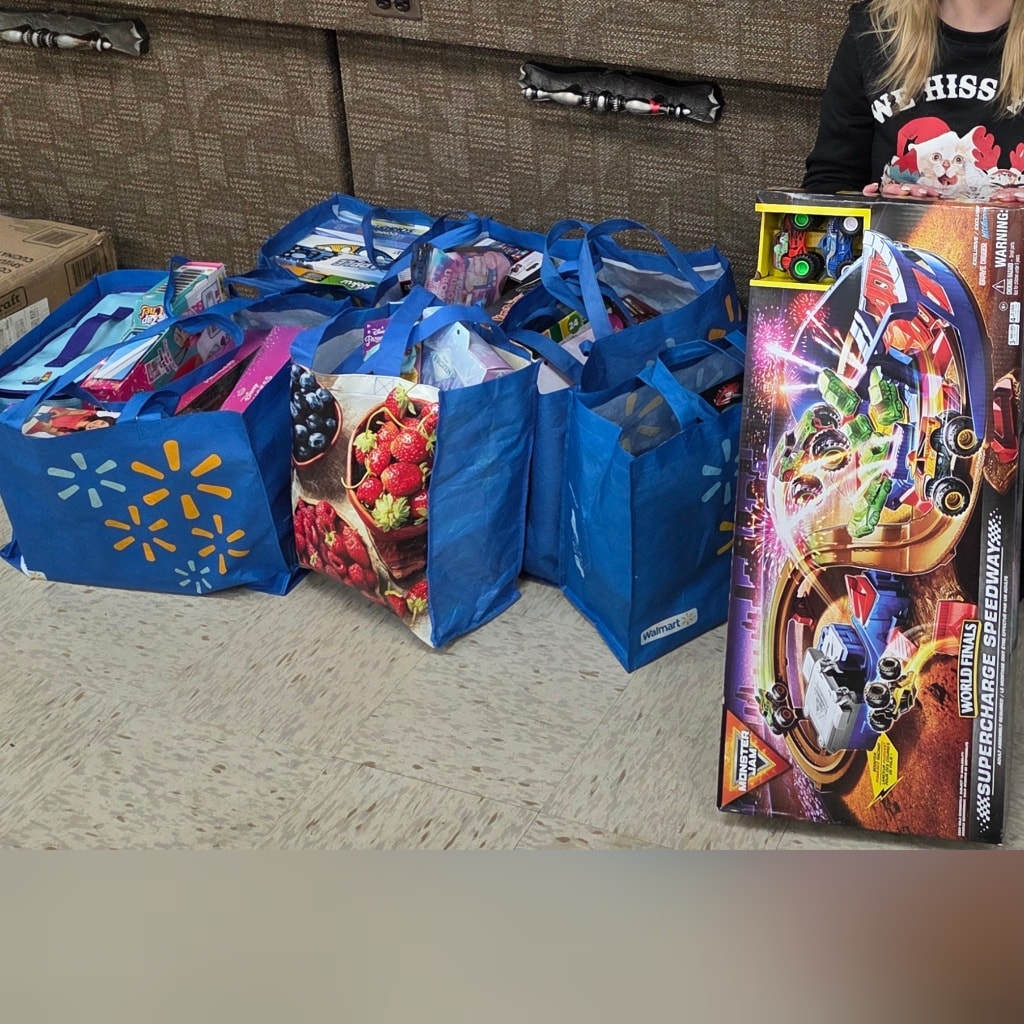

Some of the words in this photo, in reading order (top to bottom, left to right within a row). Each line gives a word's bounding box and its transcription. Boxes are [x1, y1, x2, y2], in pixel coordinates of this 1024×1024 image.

[923, 73, 998, 102] HISS
[995, 209, 1009, 268] WARNING:
[0, 294, 20, 312] raft
[568, 317, 579, 329] 24
[983, 542, 1001, 647] SPEEDWAY
[643, 619, 680, 640] Walmart
[960, 623, 977, 663] FINALS
[961, 665, 974, 715] WORLD
[977, 653, 997, 795] SUPERCHARGE
[738, 729, 750, 792] MONSTER
[748, 748, 758, 777] JAM
